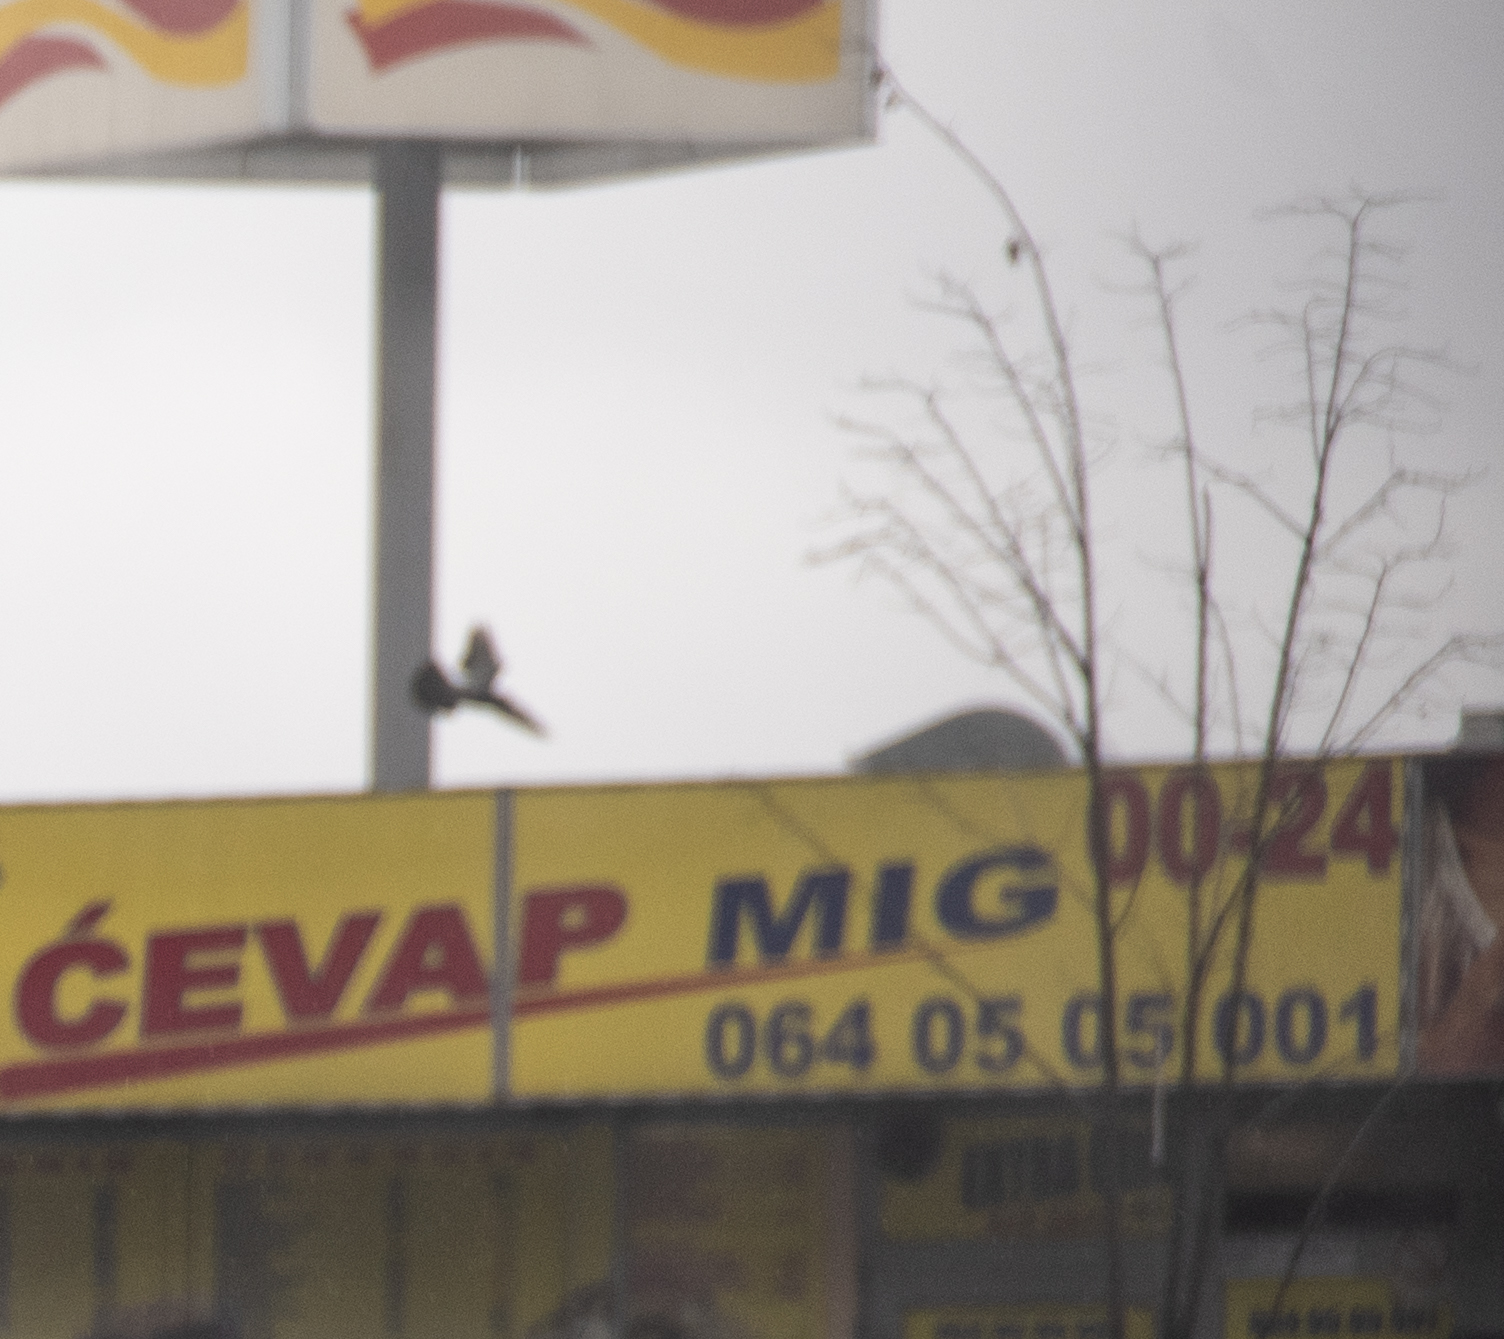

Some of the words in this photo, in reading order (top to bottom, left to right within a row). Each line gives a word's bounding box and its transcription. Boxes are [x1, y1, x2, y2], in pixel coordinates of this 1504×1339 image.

[1091, 760, 1399, 888] 00-24
[12, 882, 629, 1054] ĆEVAP
[707, 845, 1060, 970] MIG
[705, 1000, 874, 1080] 064
[913, 994, 1025, 1075] 05
[1062, 992, 1174, 1072] 05
[1212, 980, 1379, 1067] 001
